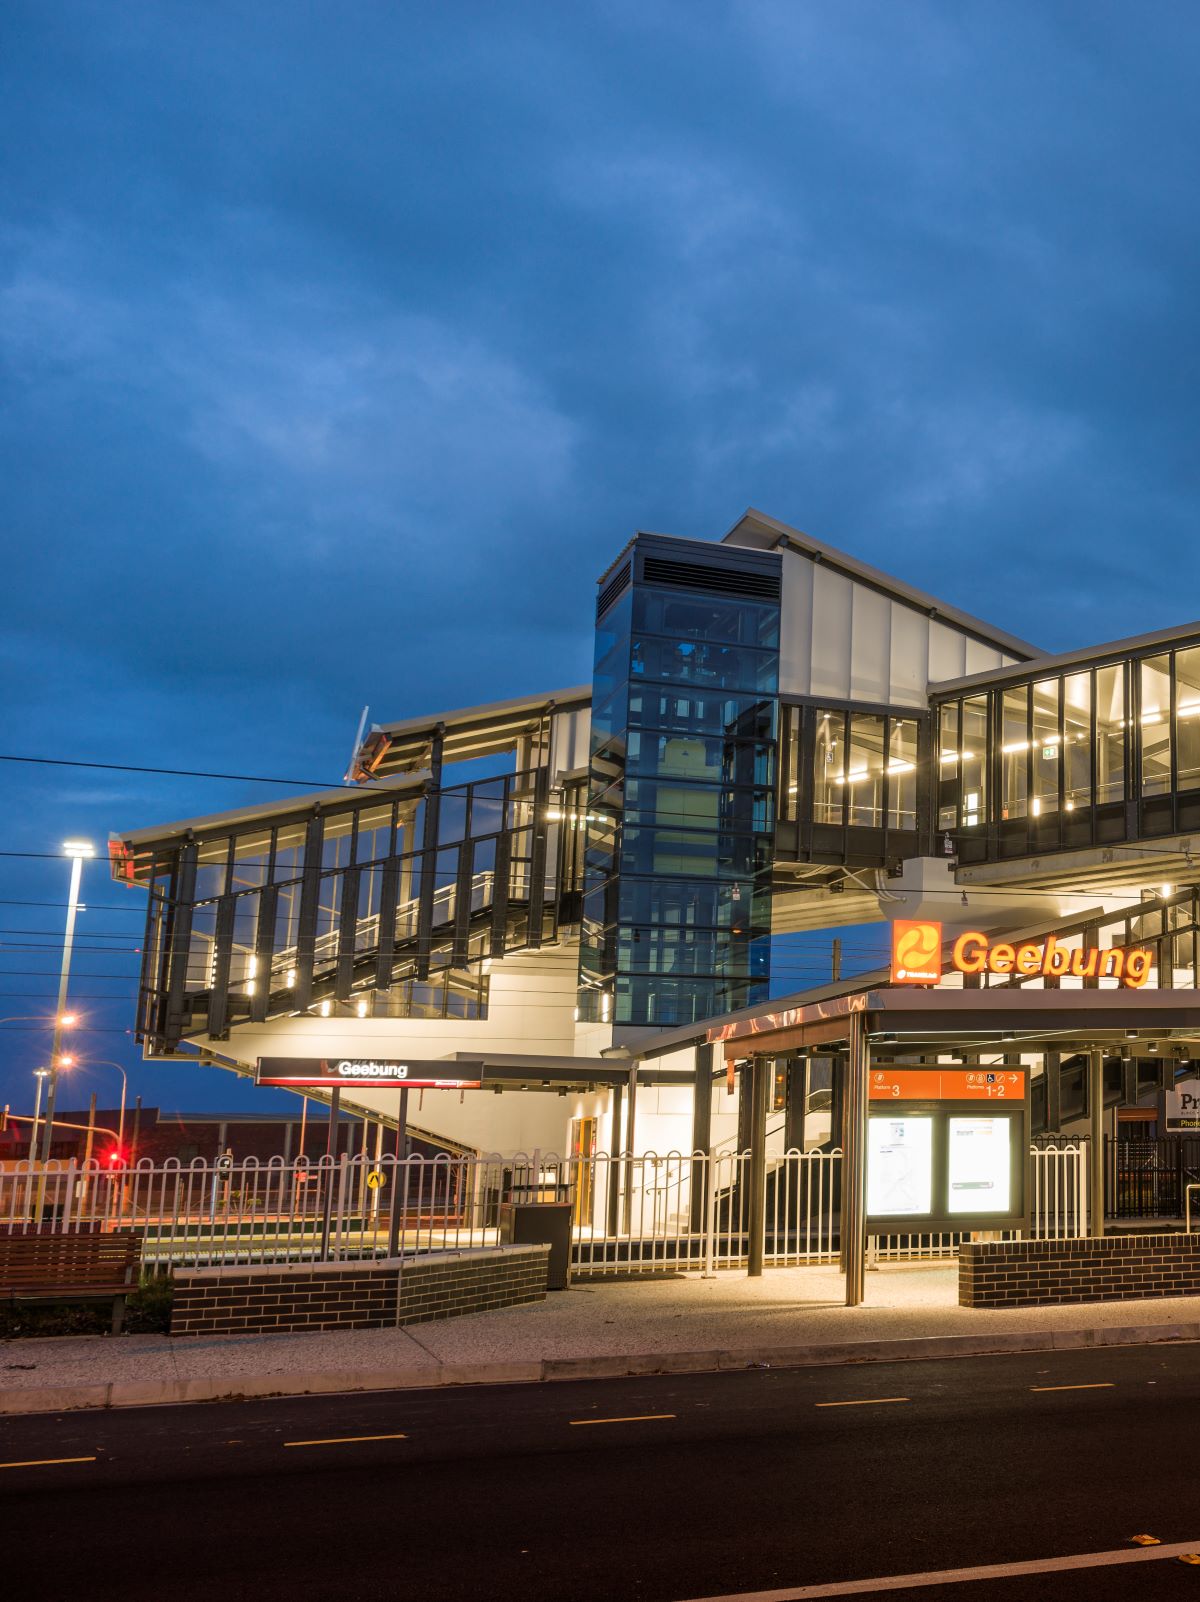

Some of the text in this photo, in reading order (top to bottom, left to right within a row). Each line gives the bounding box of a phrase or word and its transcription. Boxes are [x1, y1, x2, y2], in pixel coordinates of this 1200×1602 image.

[953, 931, 1153, 988] Geebung
[338, 1061, 408, 1078] Geebung
[892, 1085, 900, 1097] 3
[986, 1085, 1005, 1097] 1-2
